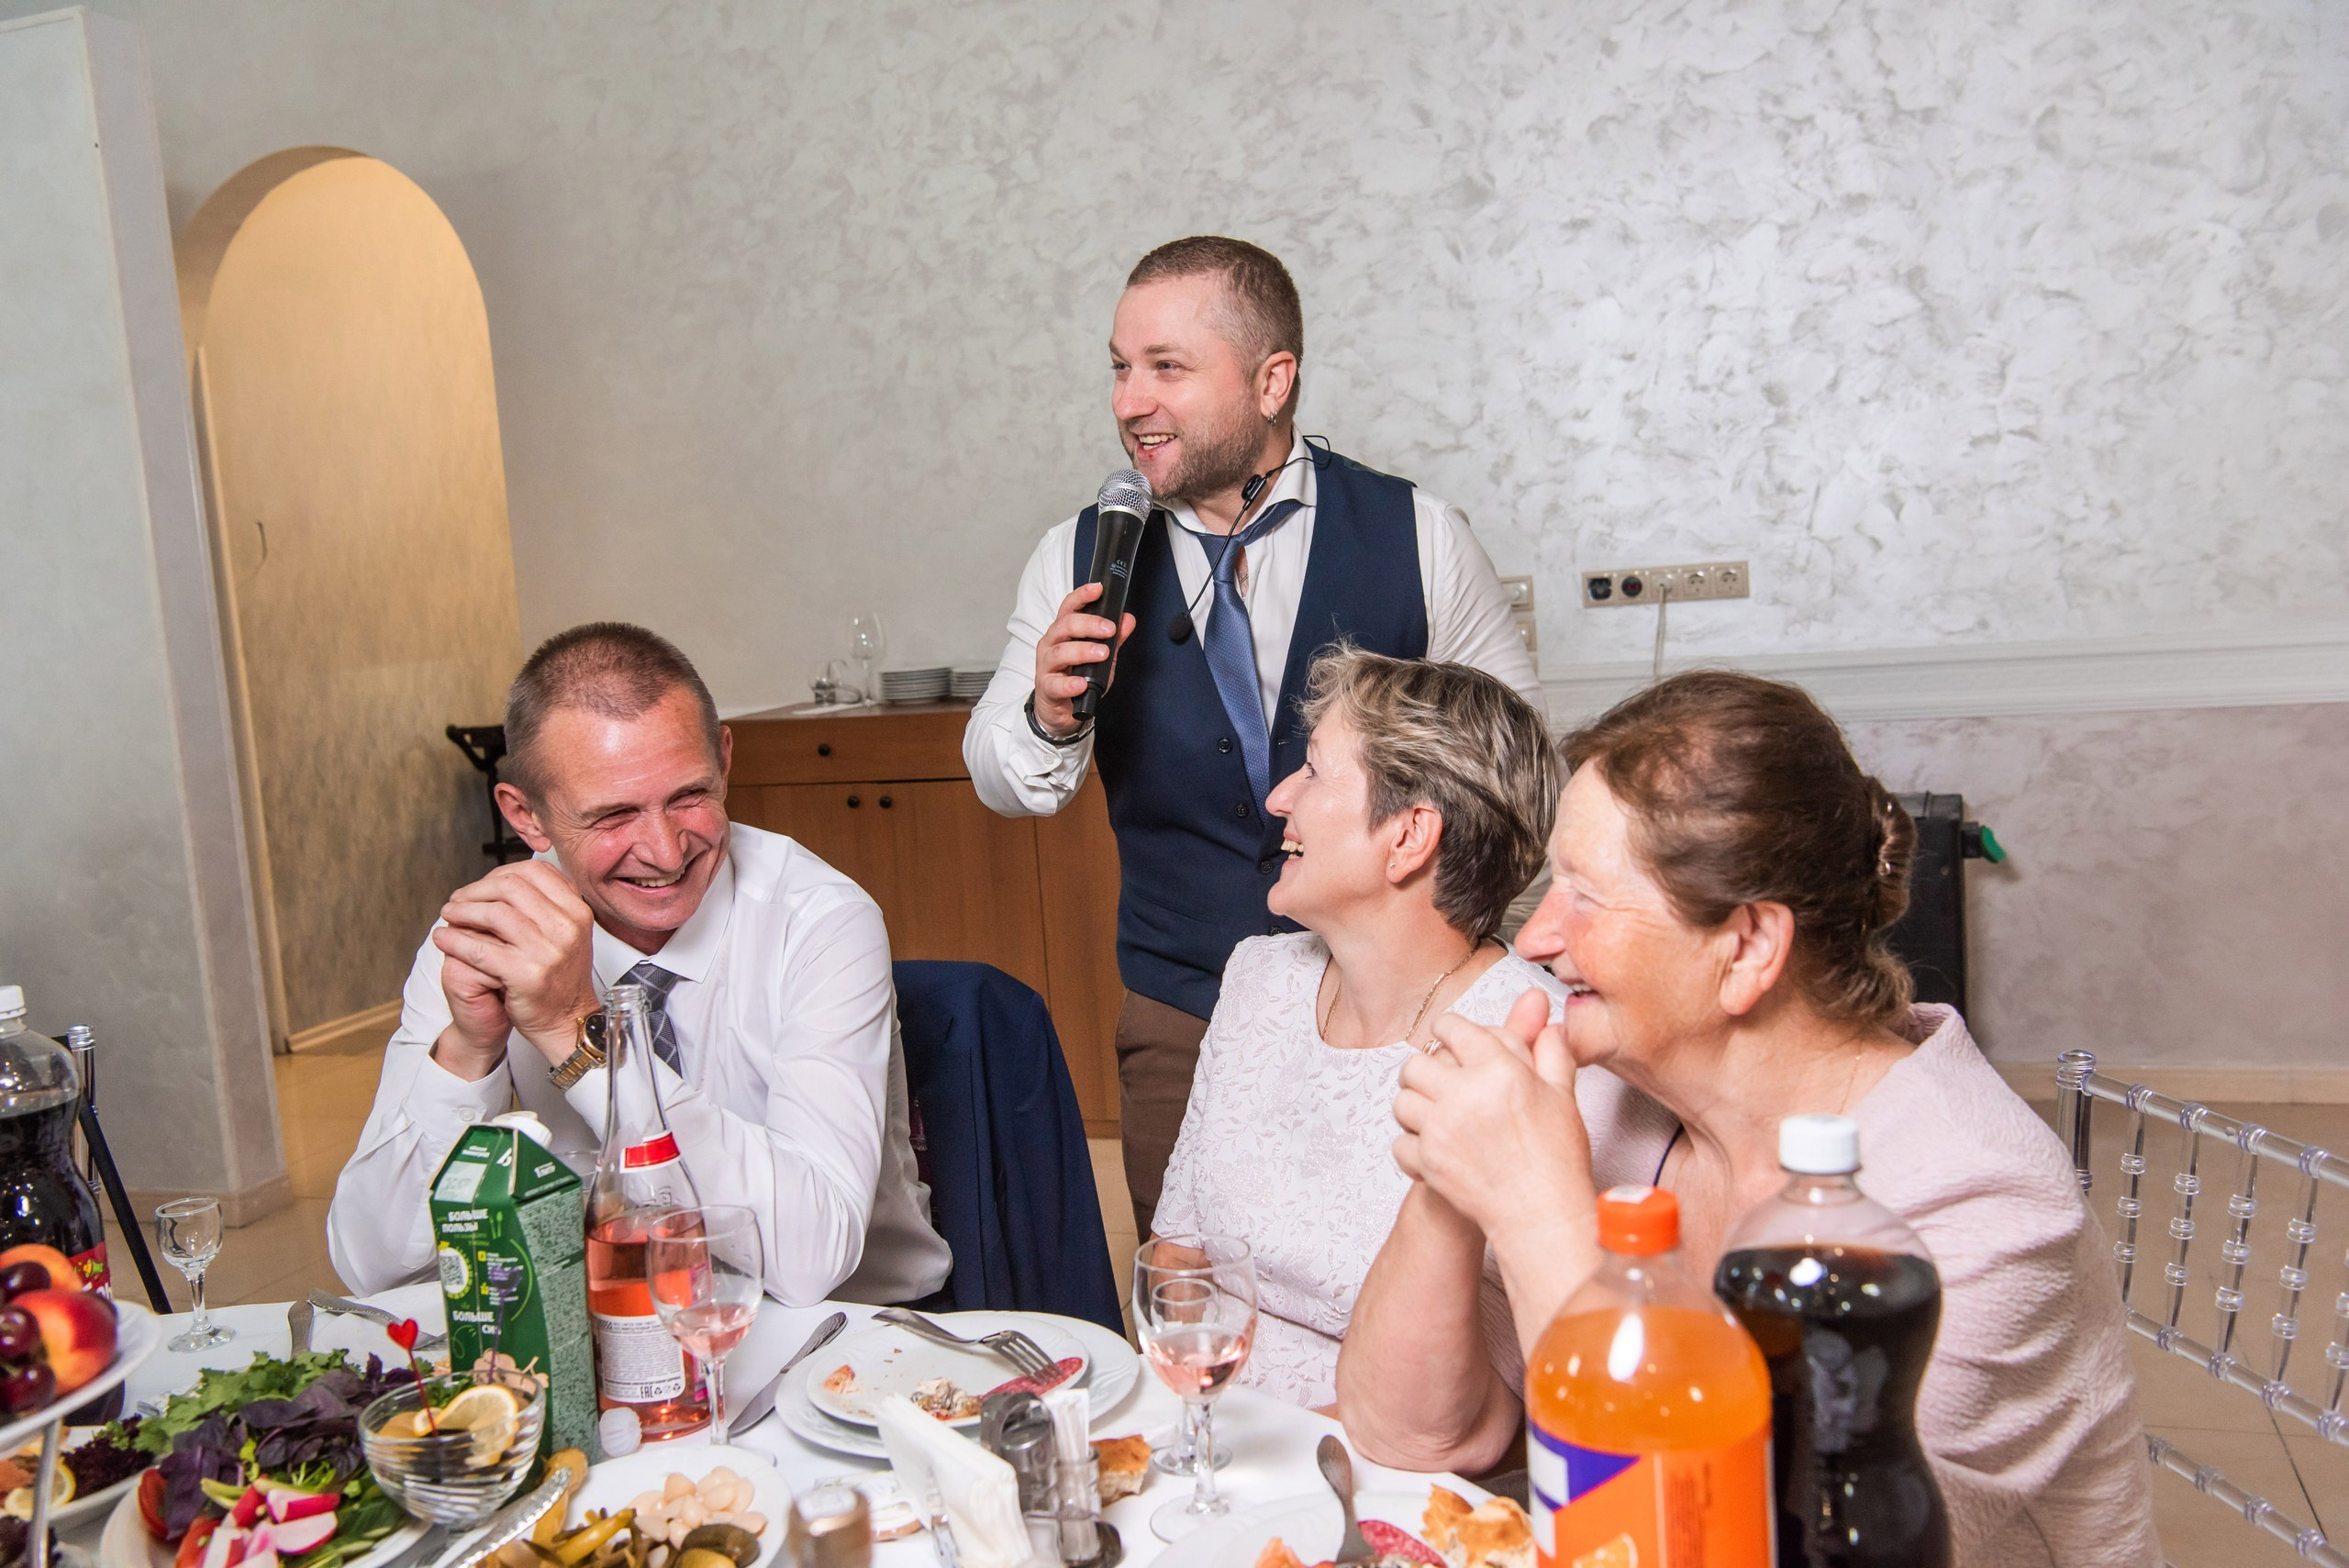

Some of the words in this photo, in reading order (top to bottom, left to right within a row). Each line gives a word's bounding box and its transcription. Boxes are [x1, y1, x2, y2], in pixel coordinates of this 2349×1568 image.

[448, 1208, 489, 1222] БОЛЬШЕ
[441, 1221, 479, 1233] ПОЛЬЗЫ
[452, 1310, 495, 1322] БОЛЬШЕ
